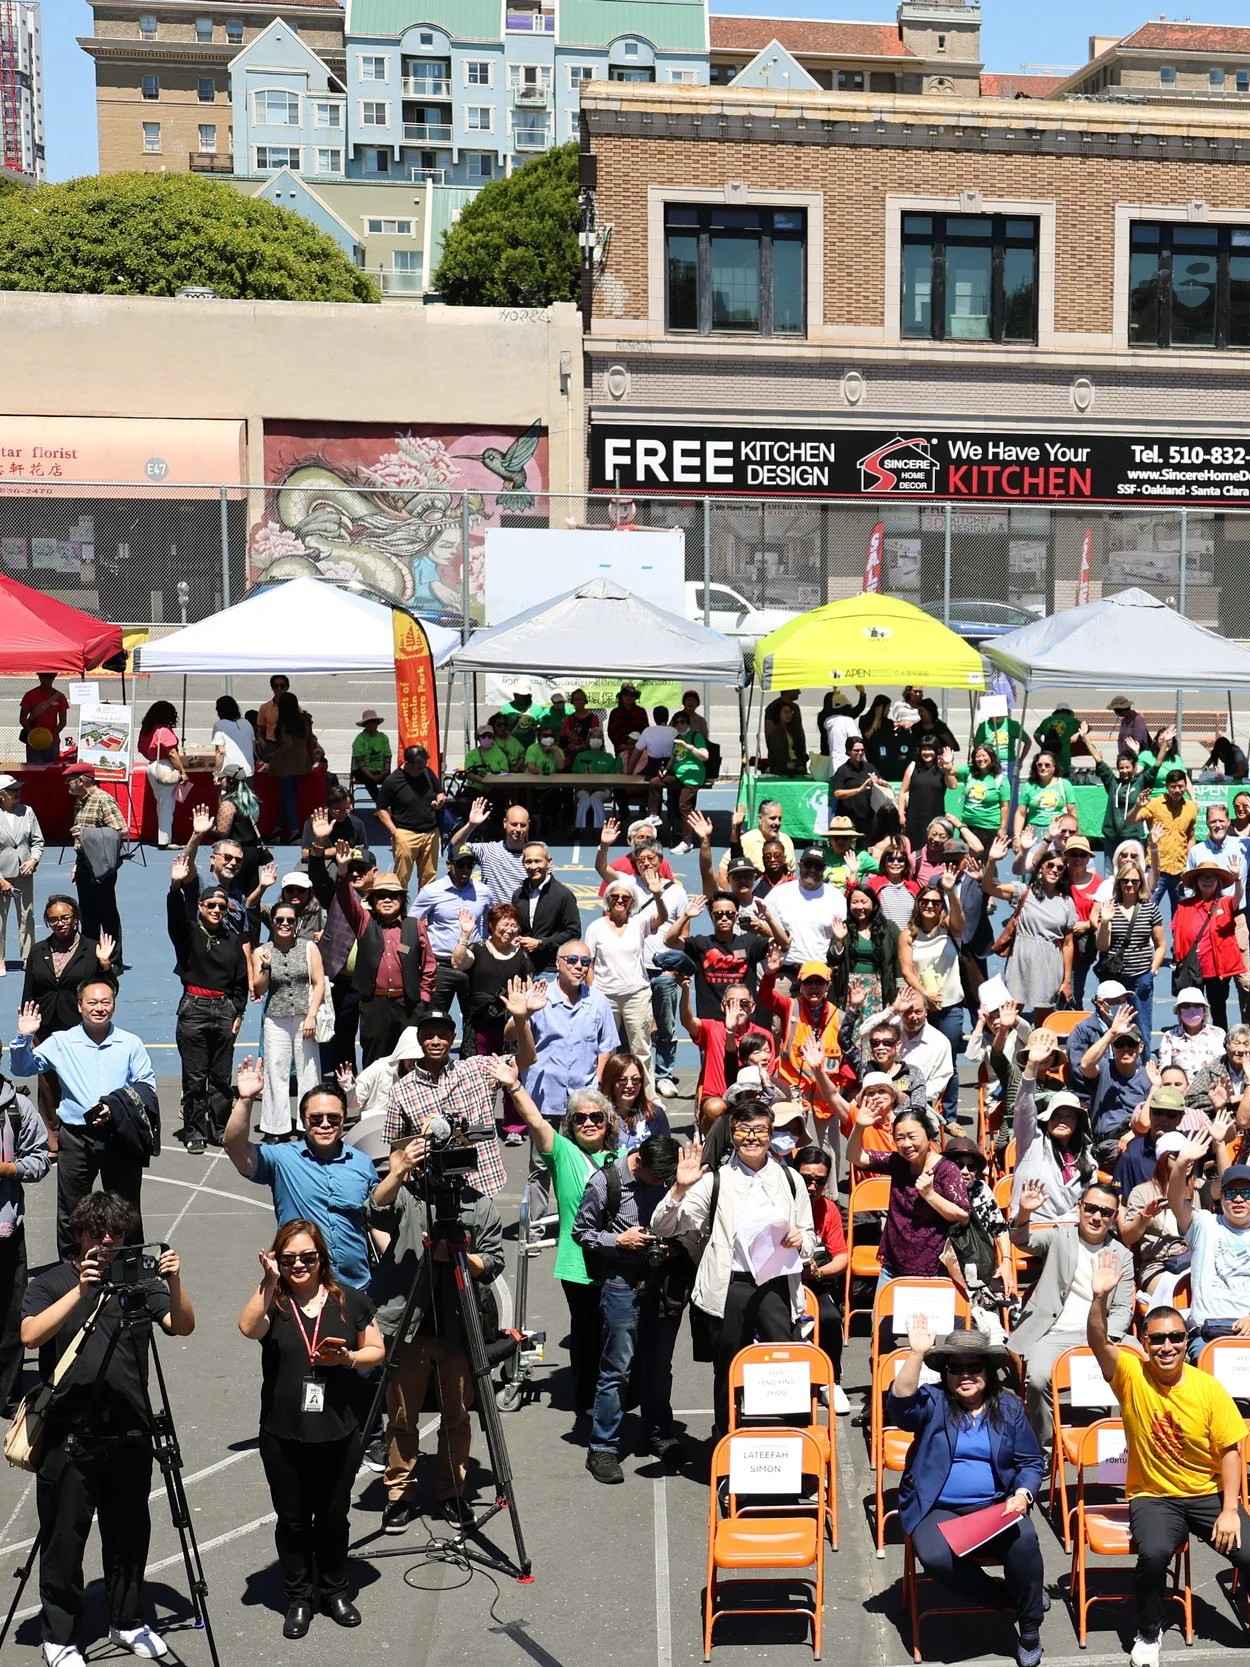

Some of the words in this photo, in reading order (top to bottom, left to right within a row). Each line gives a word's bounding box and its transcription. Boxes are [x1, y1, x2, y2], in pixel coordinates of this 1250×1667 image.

[0, 447, 22, 457] tar
[32, 447, 77, 459] florist
[740, 441, 836, 464] KITCHEN
[948, 441, 983, 460] We
[988, 441, 1040, 462] Have
[1045, 443, 1091, 463] Your
[1131, 446, 1164, 464] Tel.
[604, 438, 734, 483] FREE
[884, 459, 931, 471] SINCERE
[147, 463, 167, 476] E47
[747, 465, 829, 487] DESIGN
[901, 472, 926, 480] HOME
[900, 481, 928, 491] DECOR
[949, 465, 1092, 496] KITCHEN
[417, 664, 425, 692] Park
[845, 669, 871, 678] APEN
[409, 695, 418, 739] Lincoln
[419, 695, 429, 737] Square
[1193, 785, 1229, 796] APEN
[744, 1451, 788, 1459] LATEEFAH
[750, 1465, 781, 1473] SIMON
